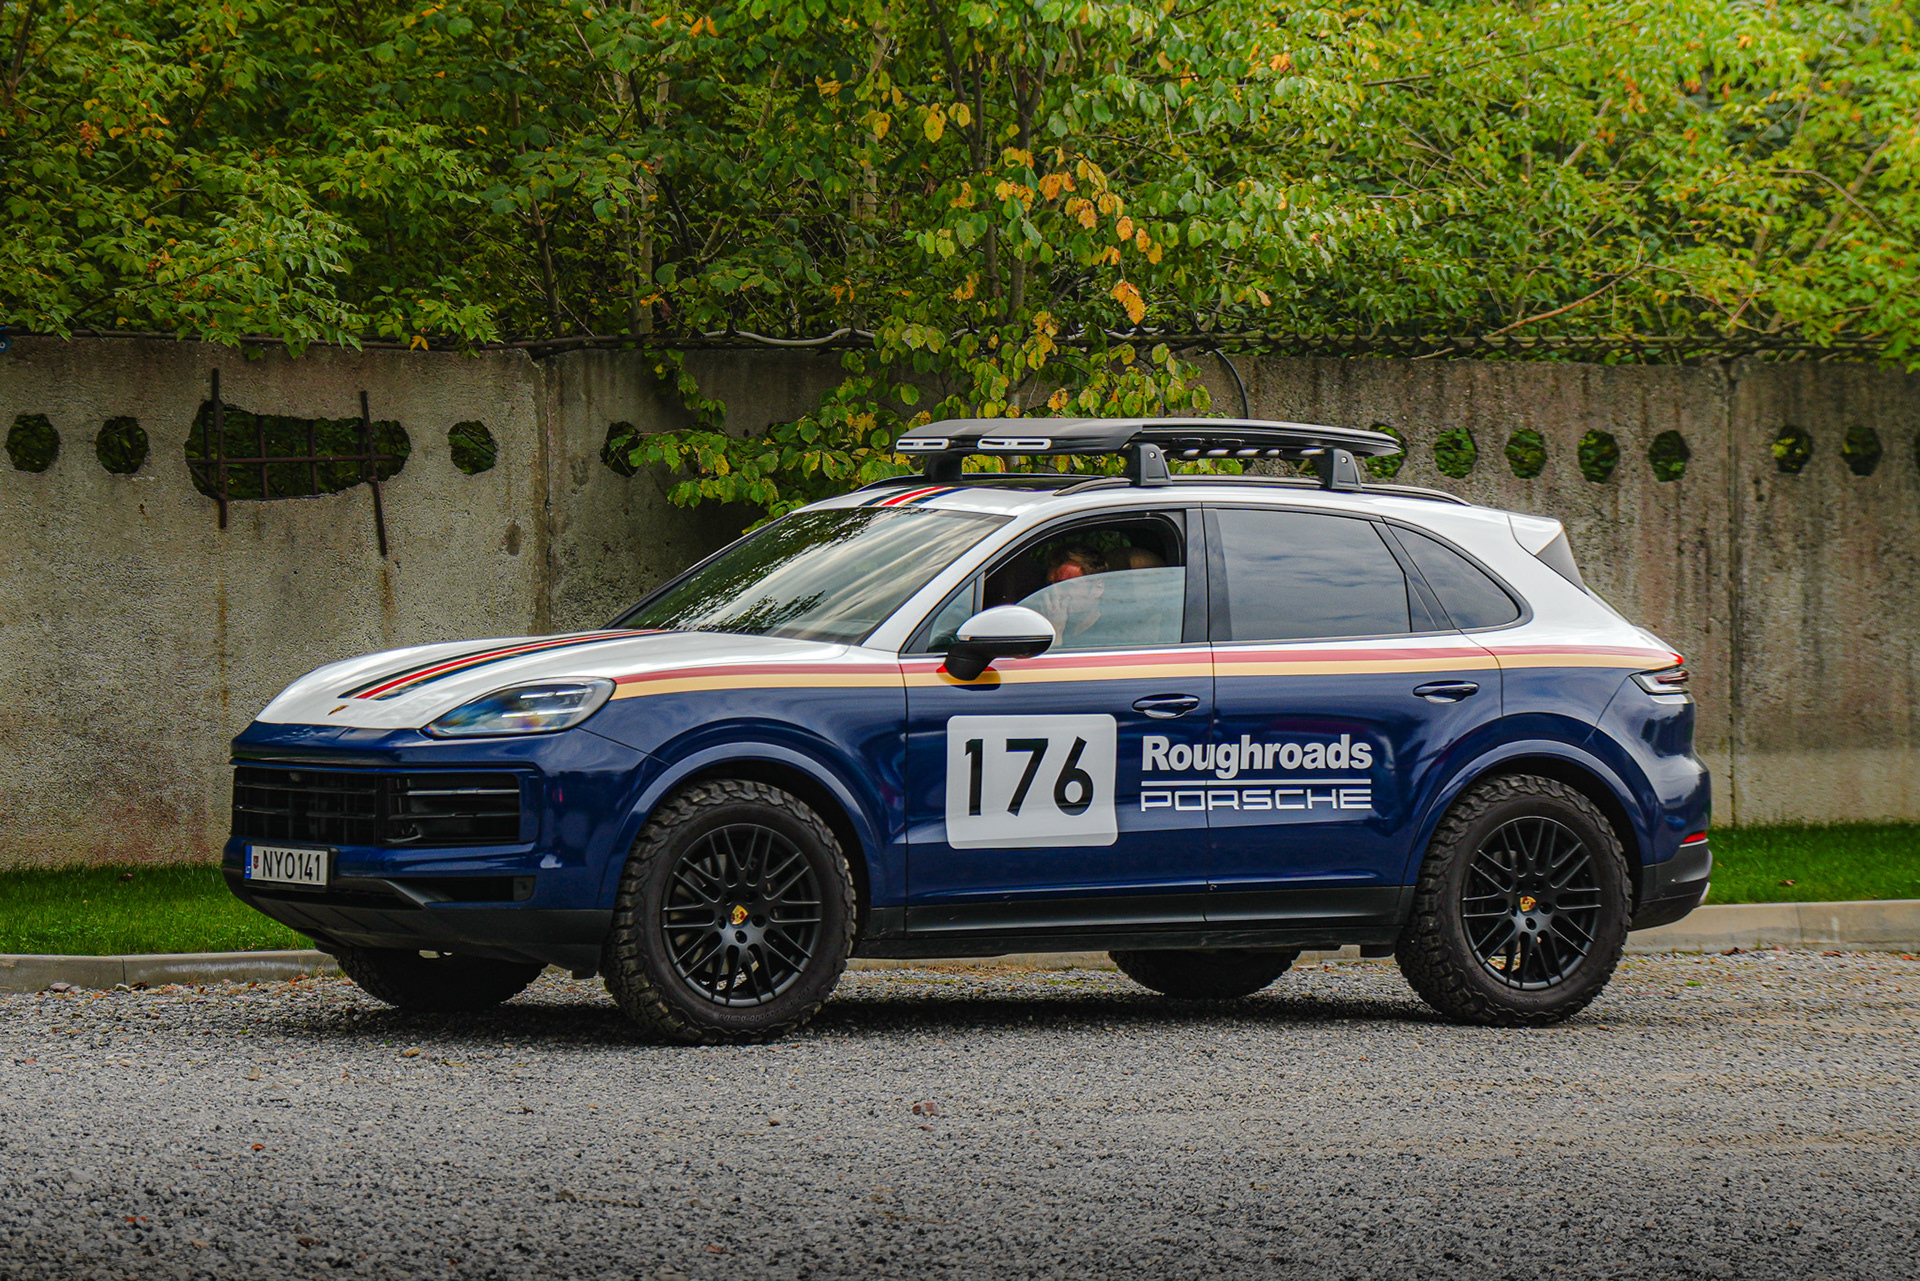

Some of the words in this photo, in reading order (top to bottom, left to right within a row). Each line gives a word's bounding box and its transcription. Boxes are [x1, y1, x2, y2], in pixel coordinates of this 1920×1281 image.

[964, 736, 1094, 817] 176
[1141, 734, 1373, 779] Roughroads
[1141, 788, 1372, 812] PORSCHE
